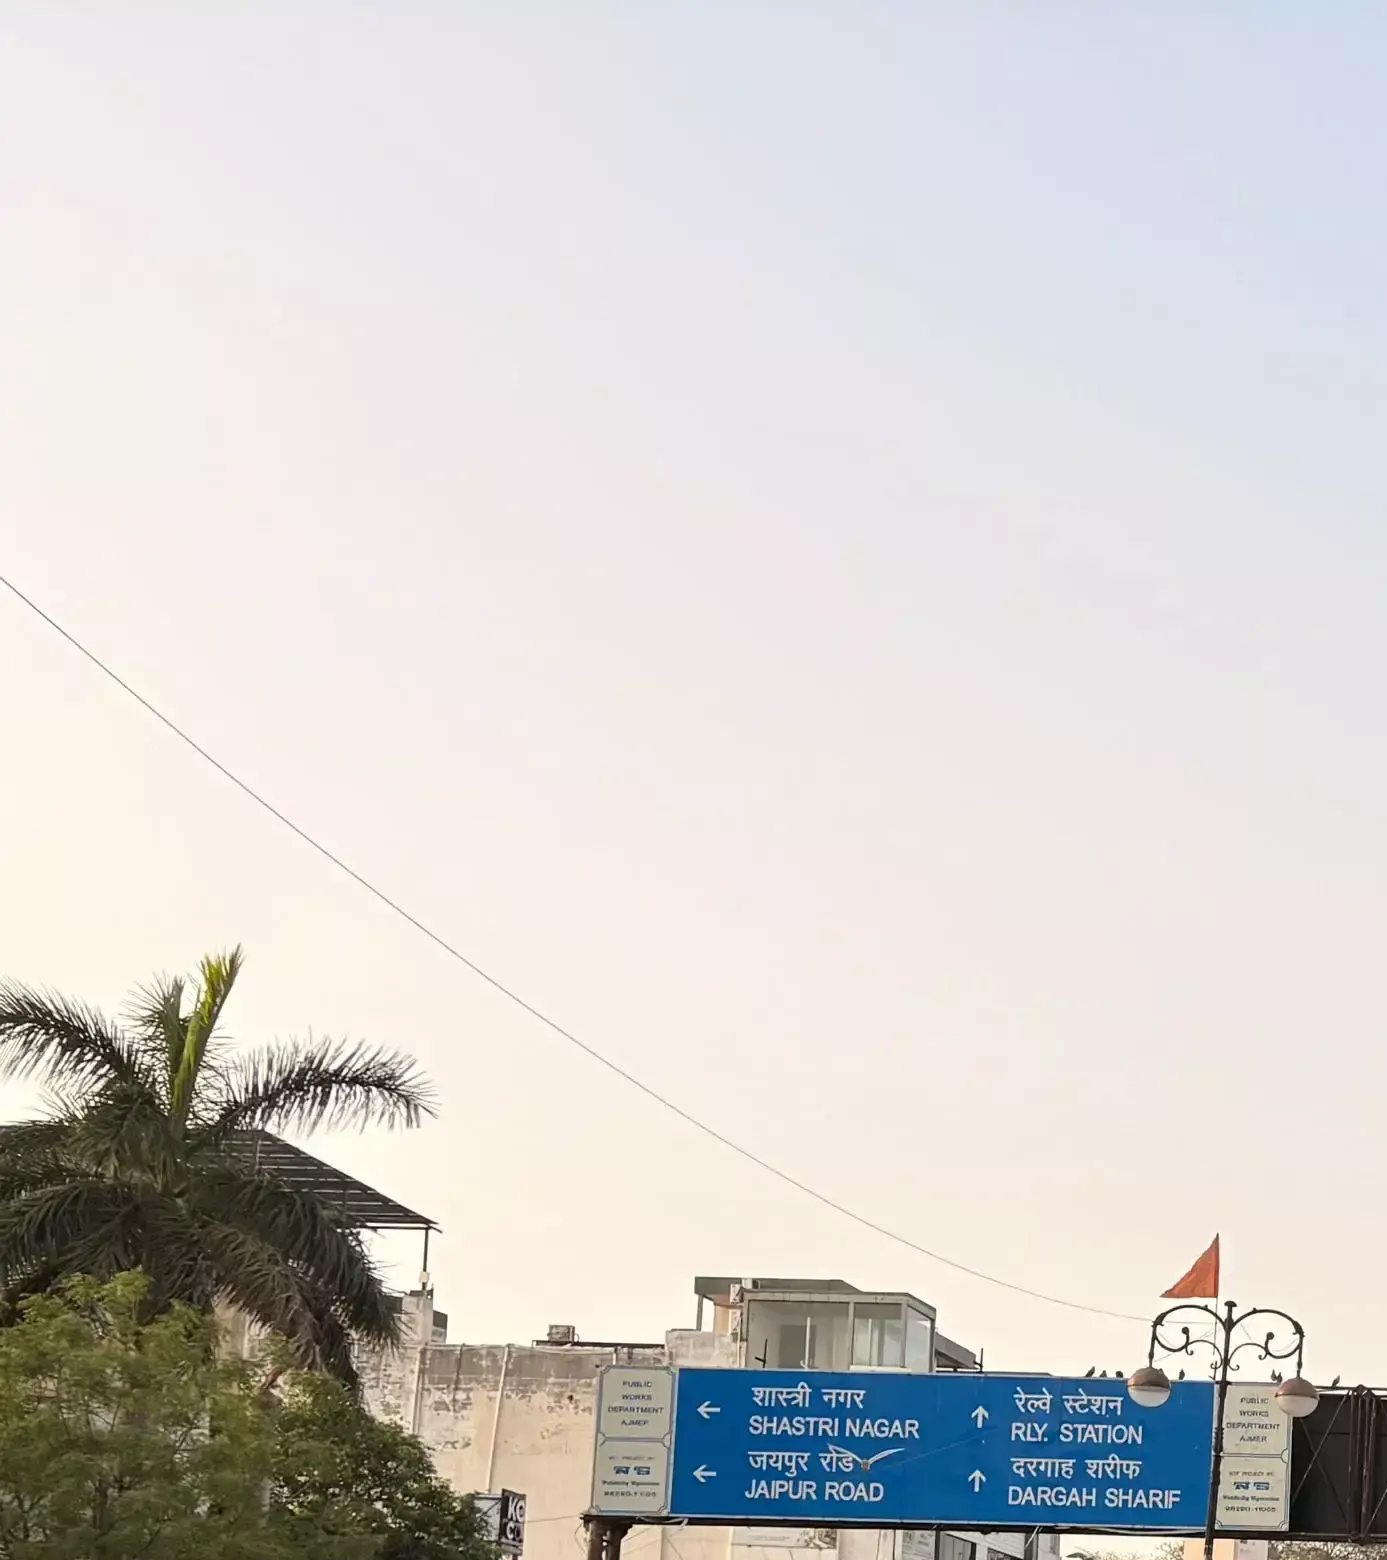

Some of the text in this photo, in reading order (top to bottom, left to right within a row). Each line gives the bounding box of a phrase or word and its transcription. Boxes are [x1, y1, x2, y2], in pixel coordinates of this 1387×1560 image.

[752, 1381, 866, 1409] शास्त्री नगर
[1013, 1387, 1123, 1417] रेल्वे स्टेशन
[749, 1414, 920, 1440] SHASTRI NAGAR
[1011, 1422, 1143, 1445] RLY. STATION
[1226, 1422, 1281, 1431] DEPARTMENT
[748, 1450, 810, 1477] जयपुर
[1010, 1454, 1142, 1480] दरगाह शरीफ
[745, 1479, 884, 1502] JAIPUR ROAD
[1007, 1485, 1181, 1509] DARGAH SHARIF
